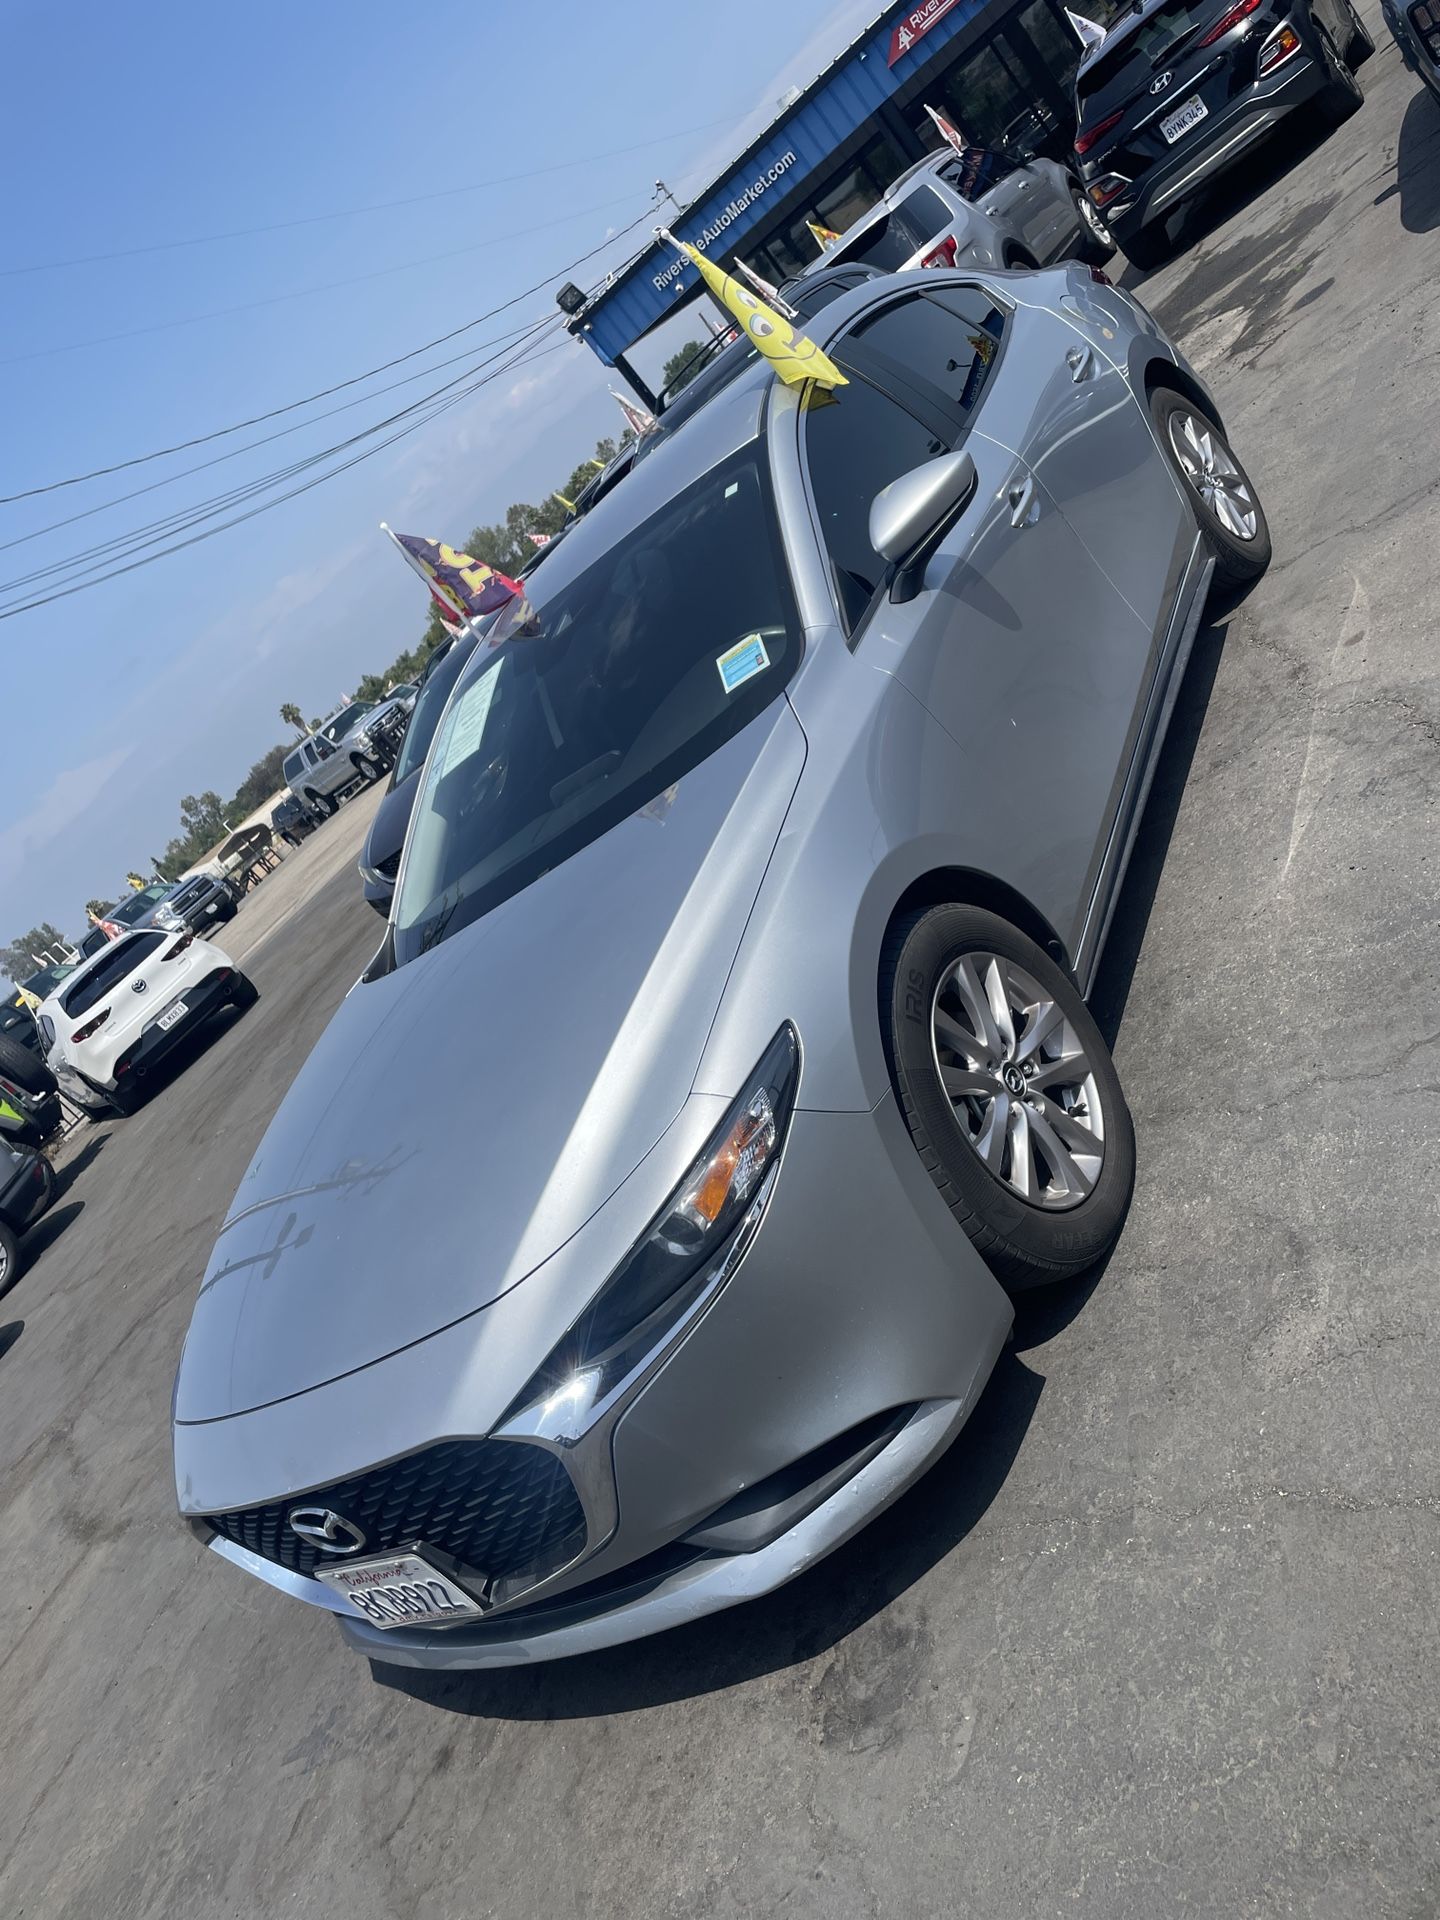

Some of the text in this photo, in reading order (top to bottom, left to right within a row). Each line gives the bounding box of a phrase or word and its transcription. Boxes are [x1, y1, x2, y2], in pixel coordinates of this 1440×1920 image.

[1166, 103, 1204, 139] 8YNK345
[652, 150, 798, 292] RiverseAutoMarket.com
[905, 968, 925, 1025] IRIS
[341, 1567, 402, 1587] California
[349, 1579, 467, 1620] 8KBB922
